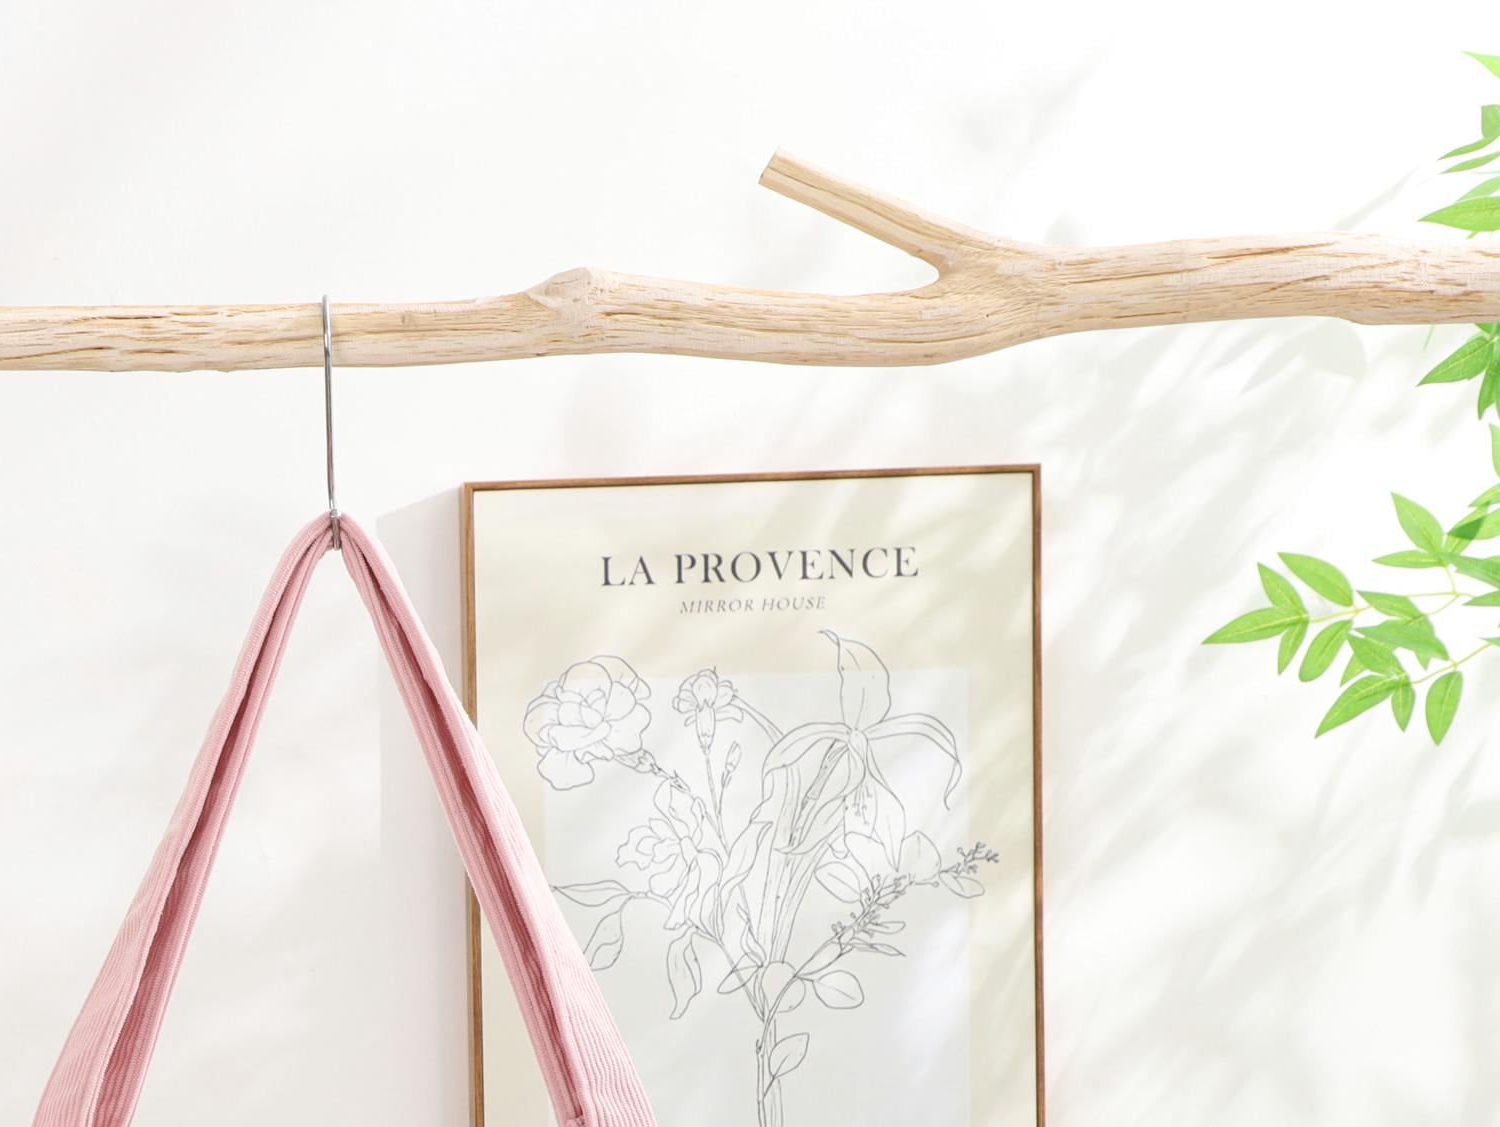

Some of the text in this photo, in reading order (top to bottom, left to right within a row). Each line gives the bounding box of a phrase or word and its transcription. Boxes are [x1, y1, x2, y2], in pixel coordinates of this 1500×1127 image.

[601, 546, 919, 587] LA PROVENCE
[679, 595, 827, 615] MIRROR HOUSE
